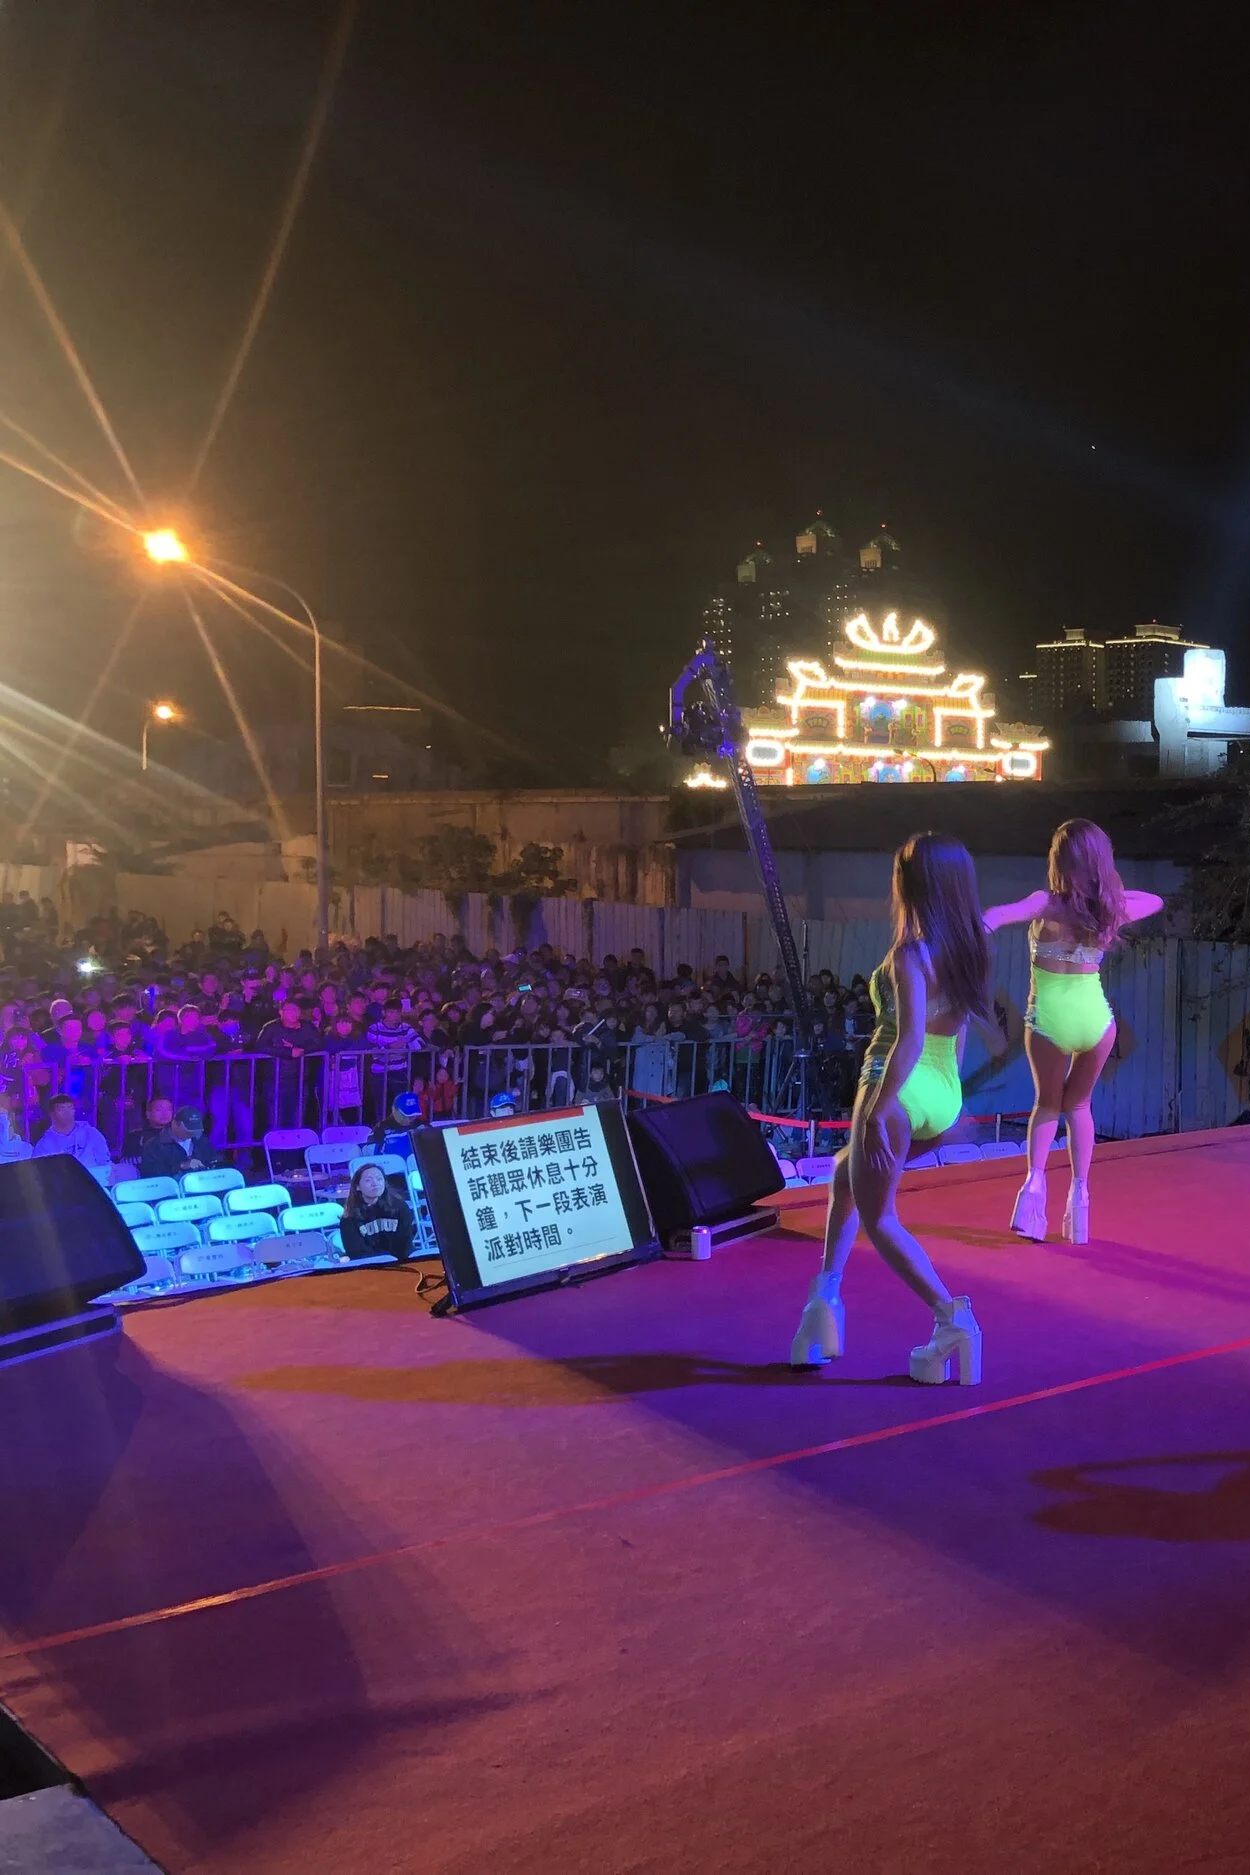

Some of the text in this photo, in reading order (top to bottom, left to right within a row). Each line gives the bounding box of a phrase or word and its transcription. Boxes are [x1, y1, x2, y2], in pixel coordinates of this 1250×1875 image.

[461, 1127, 593, 1170] 結束後請樂團告
[467, 1155, 598, 1201] 訴觀眾休息十分
